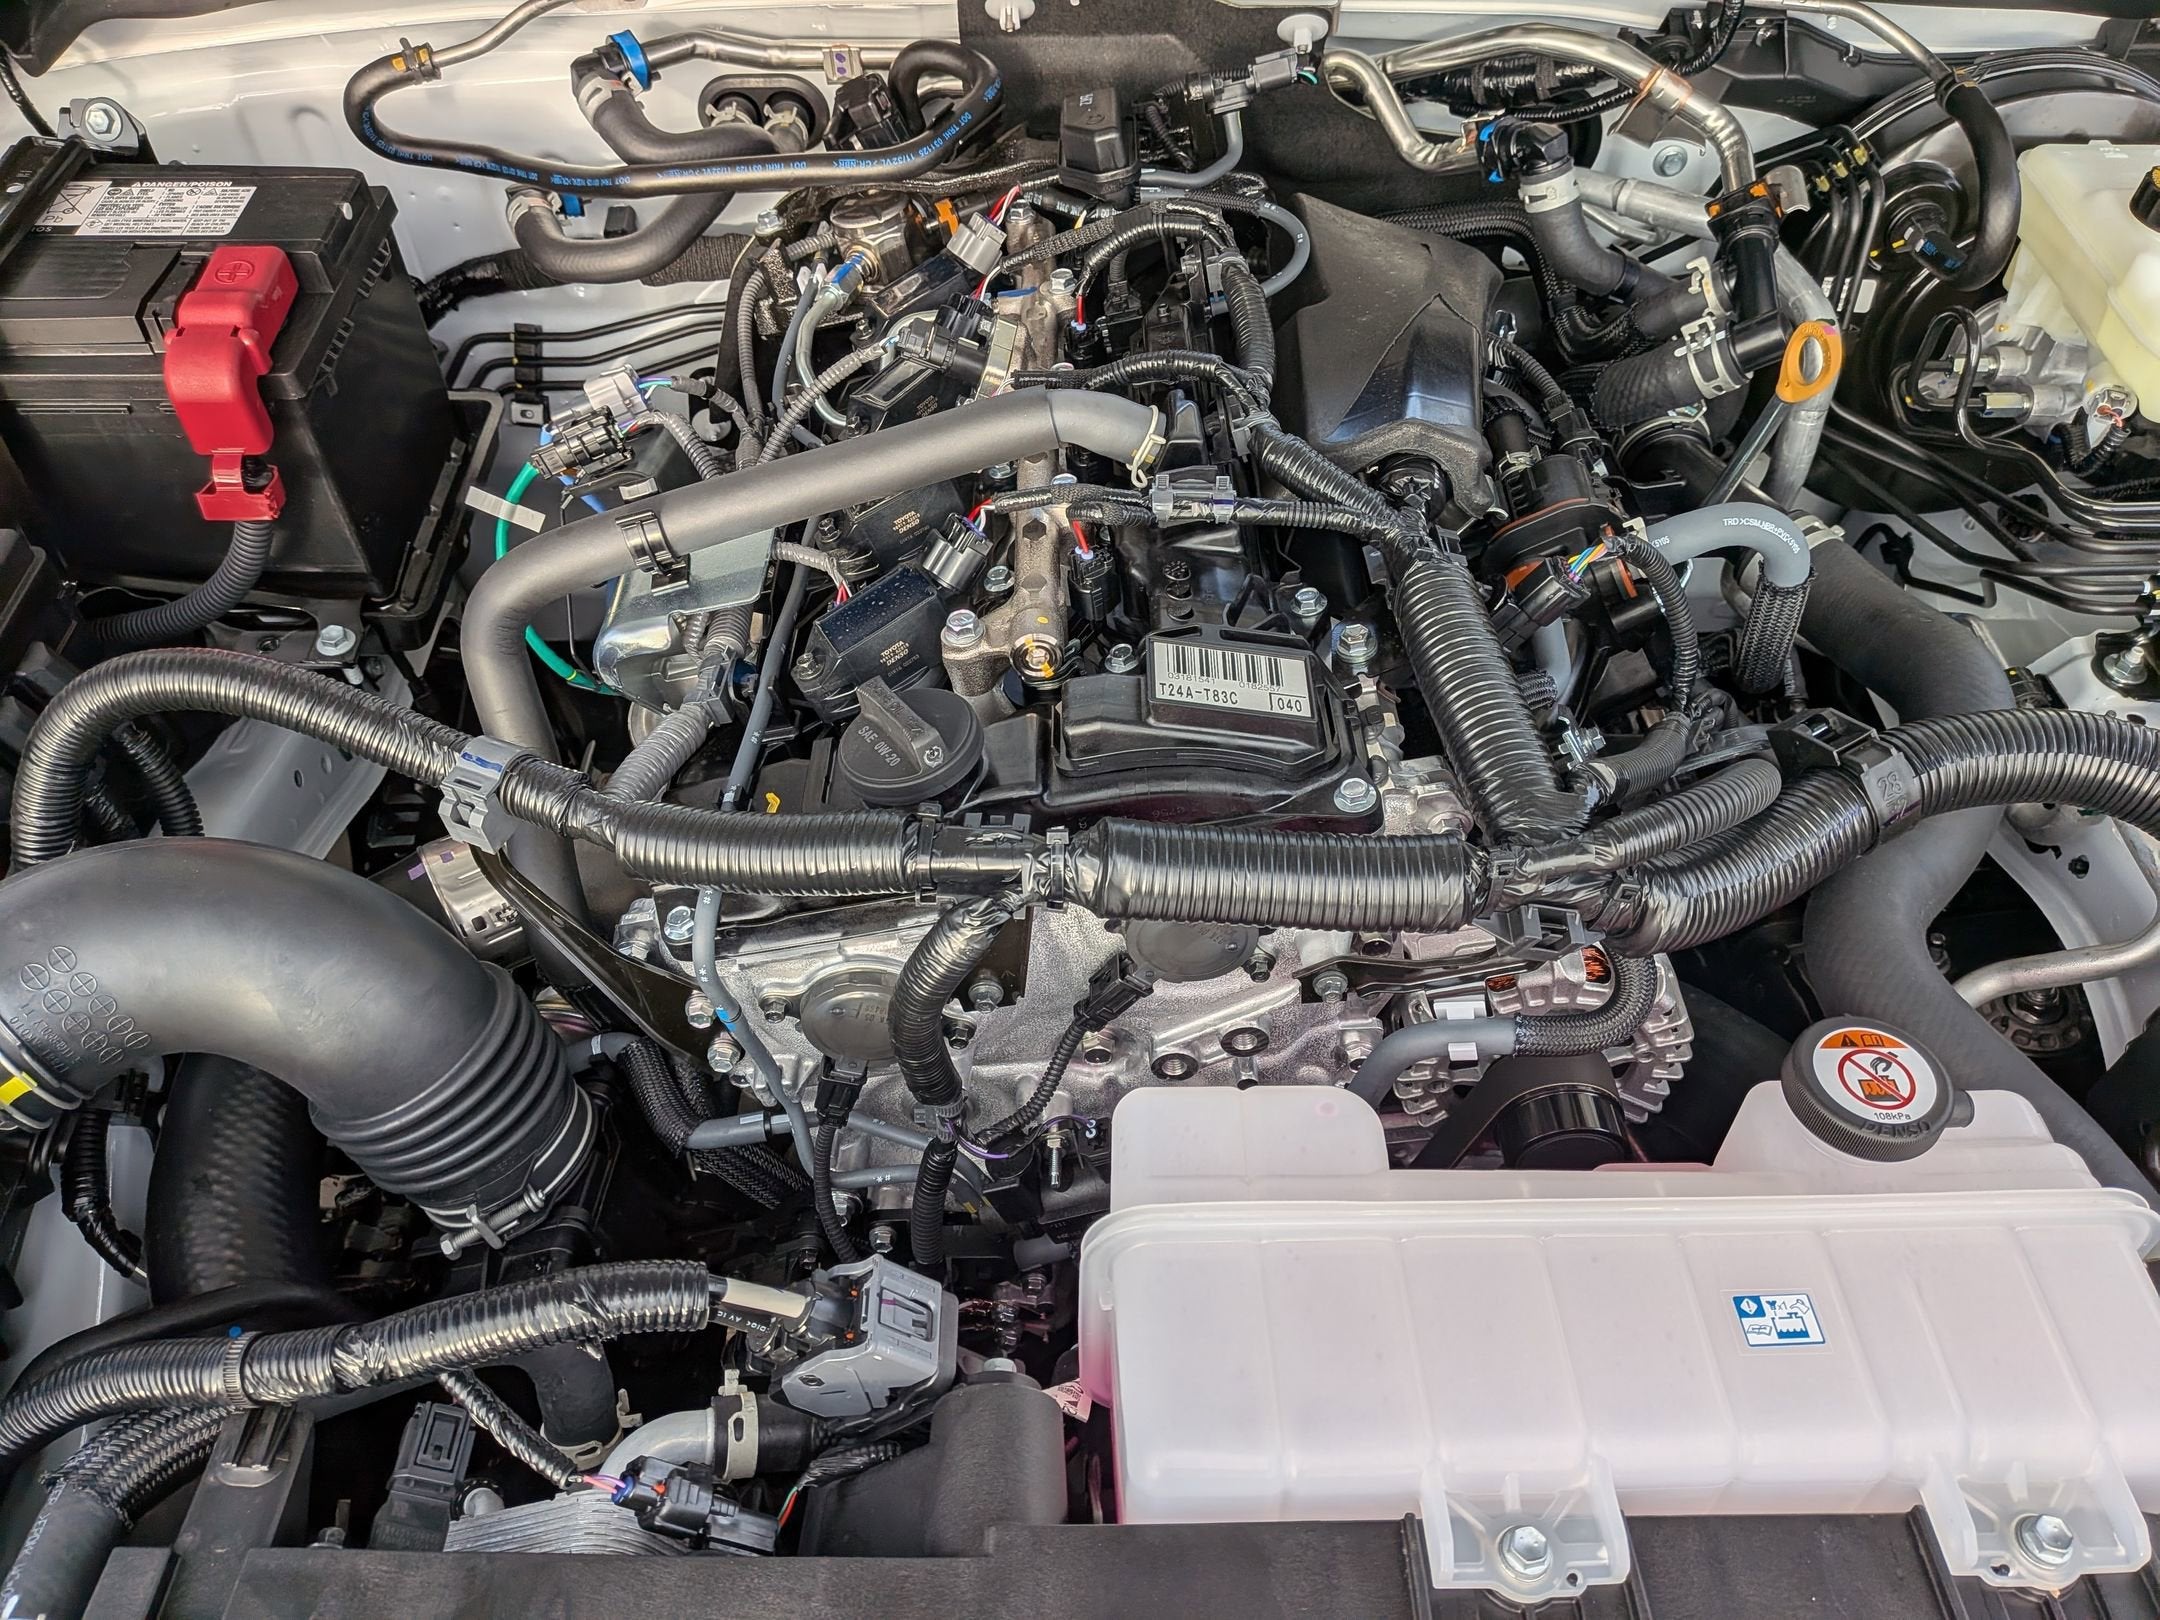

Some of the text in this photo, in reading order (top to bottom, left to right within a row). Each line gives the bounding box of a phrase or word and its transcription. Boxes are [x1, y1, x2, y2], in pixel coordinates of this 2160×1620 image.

[958, 111, 973, 127] DOT
[42, 215, 64, 223] Pb
[893, 510, 917, 526] TOYOTA
[898, 519, 920, 534] DENSO
[880, 640, 905, 657] TOYOTA
[886, 649, 909, 667] DENSO
[1167, 672, 1216, 684] 03181541
[1239, 681, 1281, 692] 0182557
[1159, 682, 1303, 713] T24A-T83C 040
[858, 725, 901, 768] SAE 0W-20
[1873, 1112, 1912, 1121] 108kPa
[1860, 1121, 1931, 1137] DENSO
